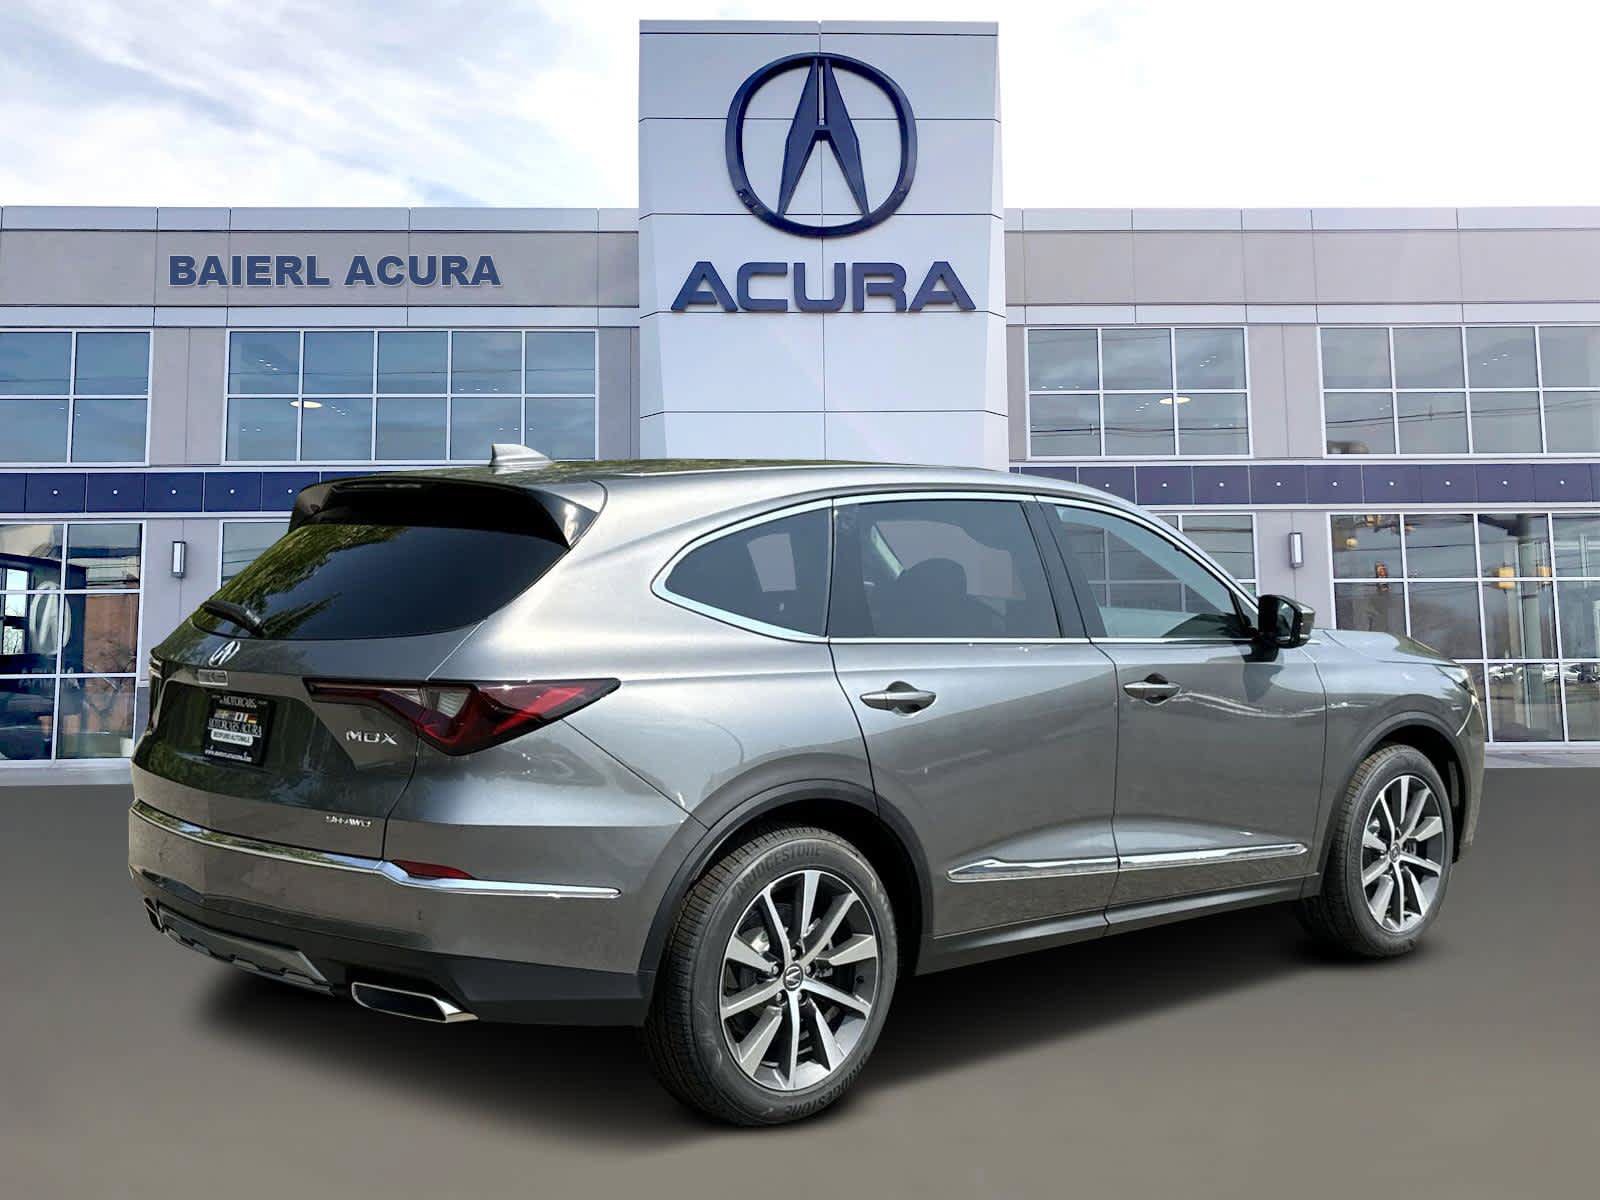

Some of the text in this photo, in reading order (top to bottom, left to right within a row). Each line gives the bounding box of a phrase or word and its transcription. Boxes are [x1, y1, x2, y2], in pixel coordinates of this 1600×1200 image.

[168, 255, 502, 287] BAIERL ACURA
[670, 261, 977, 313] ACURA
[345, 729, 398, 745] MDX
